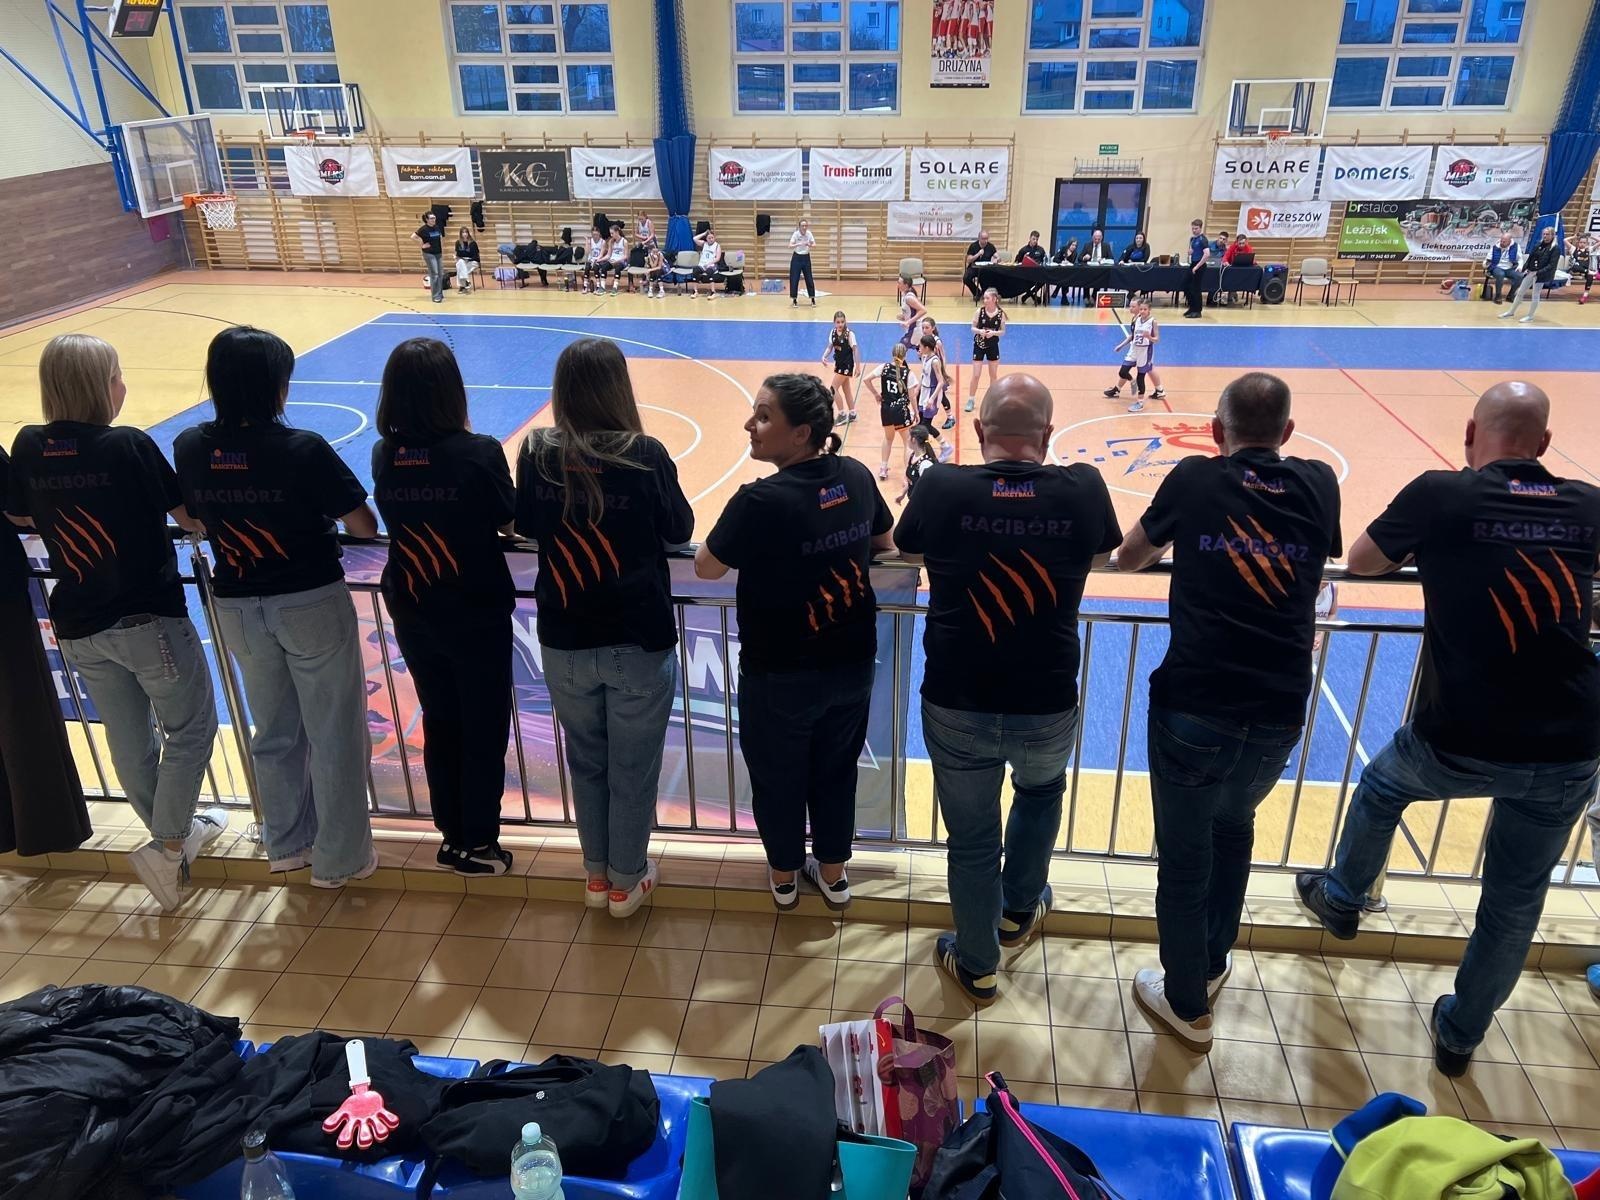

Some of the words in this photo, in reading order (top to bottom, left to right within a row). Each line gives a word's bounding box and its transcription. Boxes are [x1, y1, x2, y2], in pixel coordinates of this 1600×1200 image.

[585, 166, 652, 178] CUTLINE
[823, 165, 892, 178] TransForma
[920, 161, 999, 174] SOLARE
[1225, 160, 1310, 173] SOLARE
[927, 179, 991, 190] ENERGY
[1231, 178, 1300, 189] ENERGY
[1348, 200, 1399, 213] brstalco
[1273, 212, 1322, 222] rzeszów
[919, 222, 953, 236] KLUB
